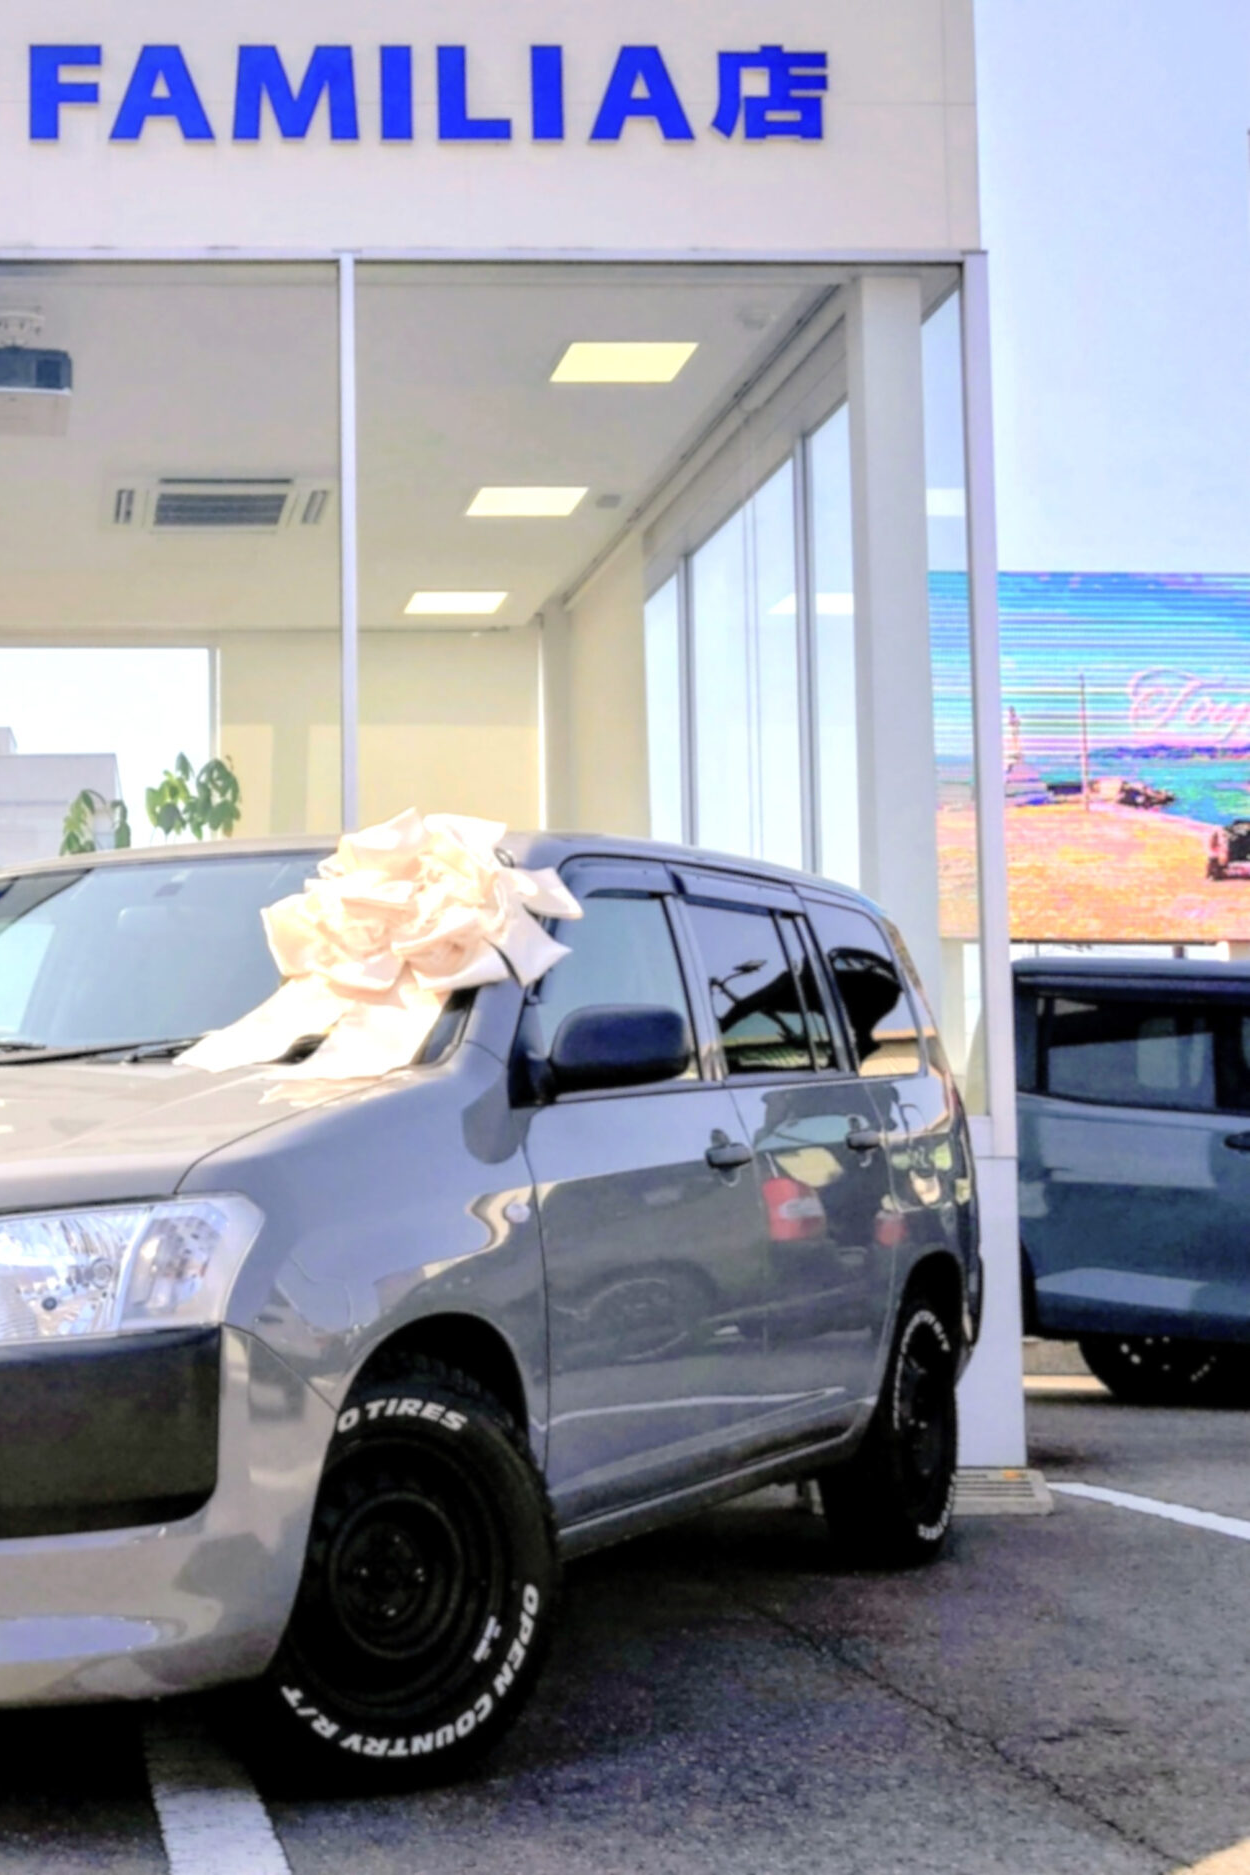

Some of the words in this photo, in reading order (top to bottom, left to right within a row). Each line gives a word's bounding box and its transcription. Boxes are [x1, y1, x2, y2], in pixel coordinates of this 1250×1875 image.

[364, 1397, 470, 1432] TIRES
[493, 1583, 540, 1698] OPEN
[340, 1691, 493, 1757] COUNTRY
